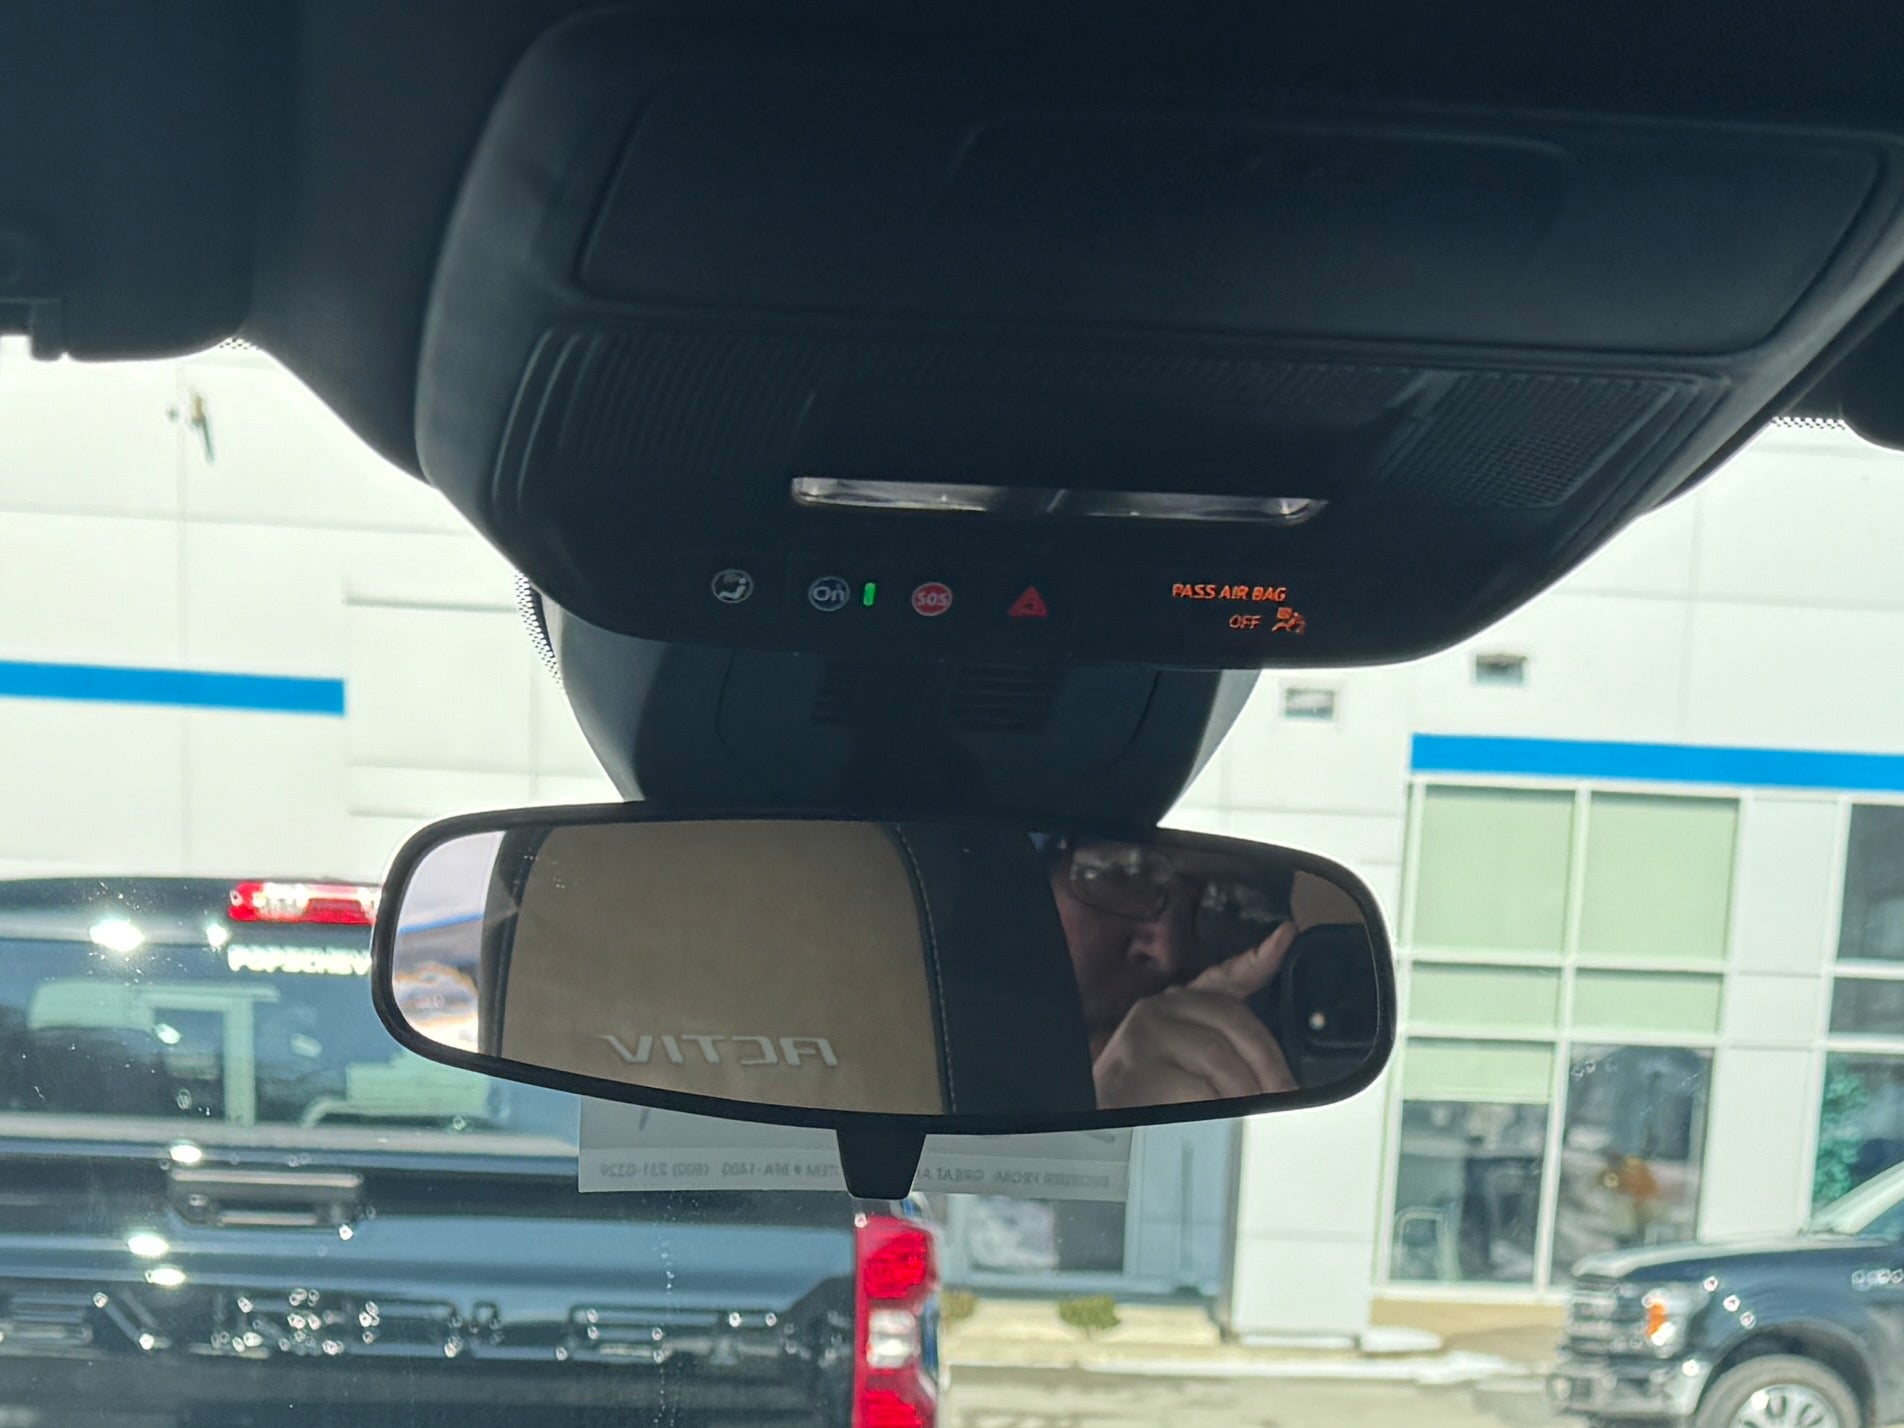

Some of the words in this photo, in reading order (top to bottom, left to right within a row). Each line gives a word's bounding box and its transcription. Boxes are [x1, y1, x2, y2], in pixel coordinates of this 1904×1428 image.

[917, 591, 948, 607] SOS
[1172, 583, 1217, 600] PASS
[1219, 585, 1250, 602] AIR
[1251, 586, 1287, 603] BAG
[1228, 614, 1261, 629] OFF
